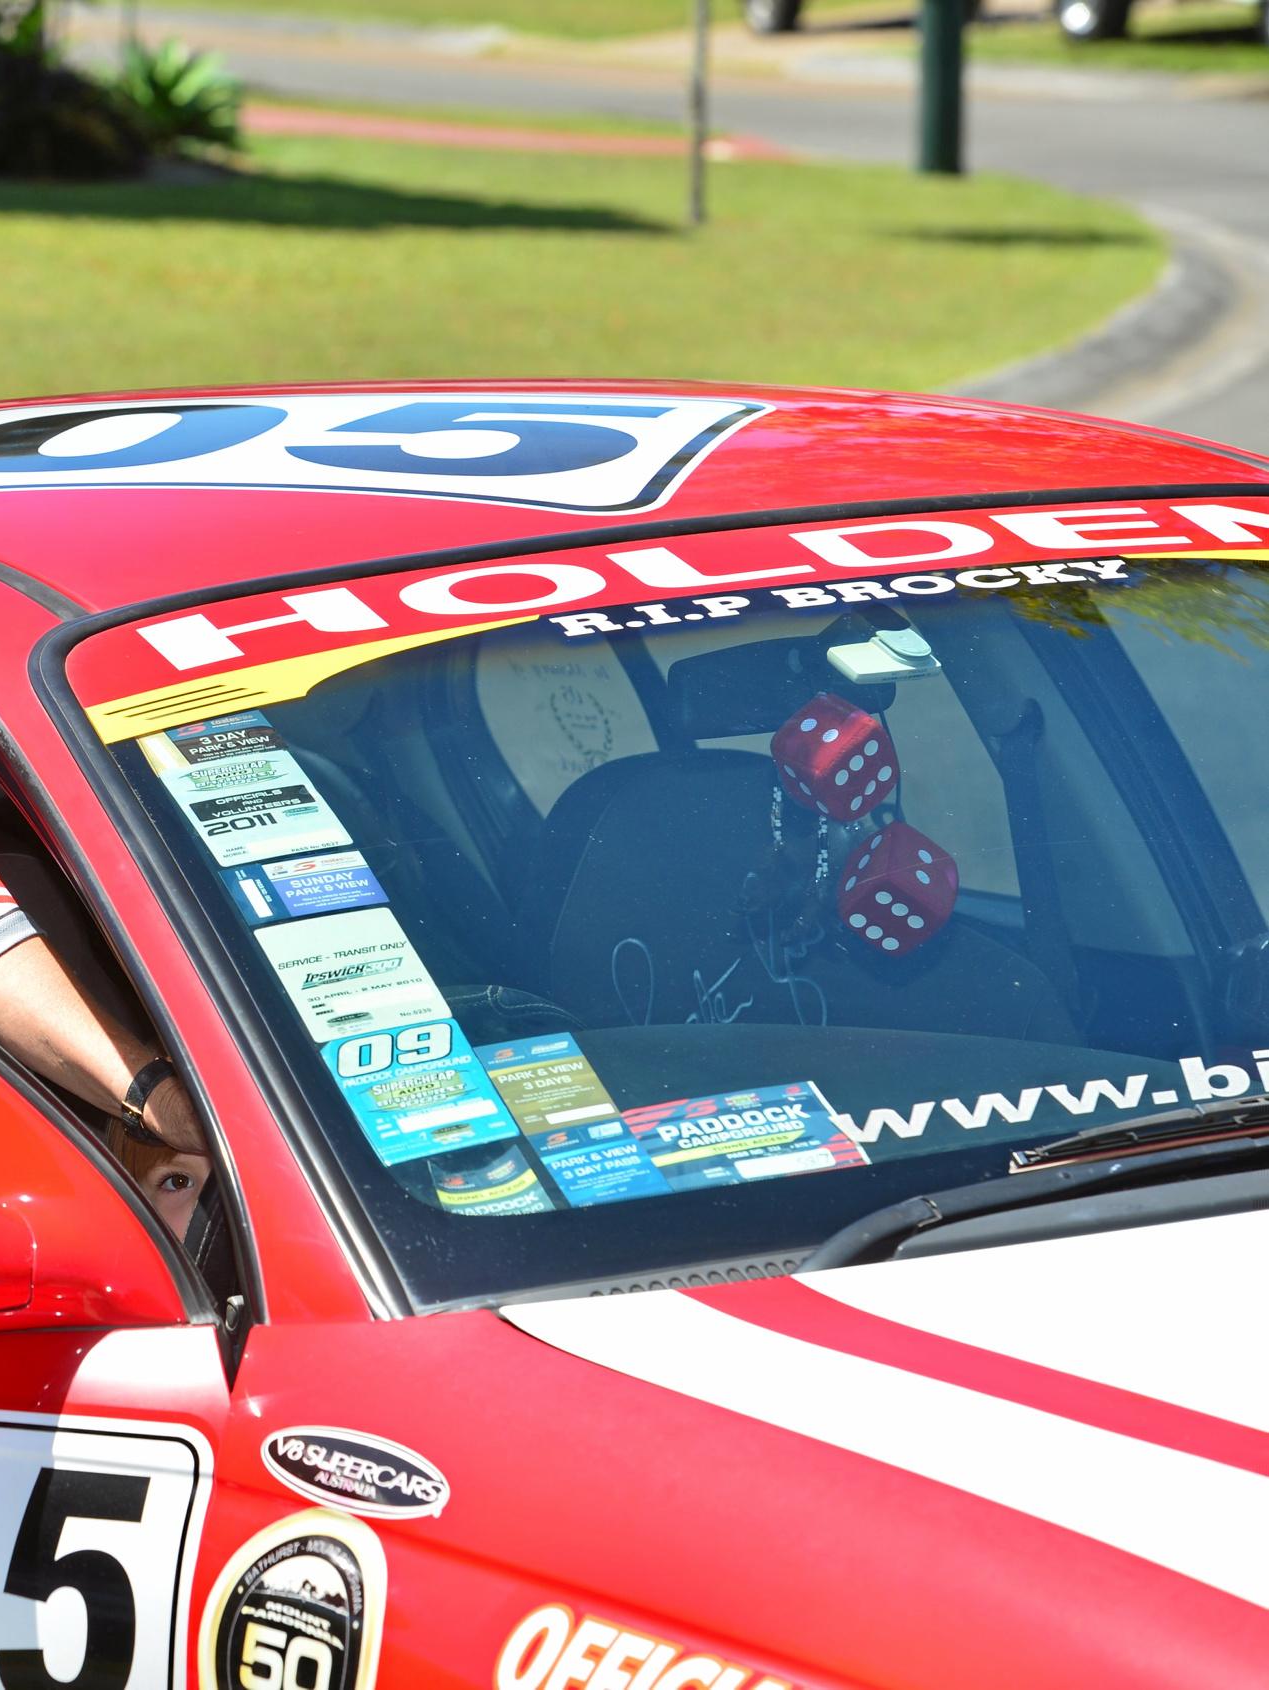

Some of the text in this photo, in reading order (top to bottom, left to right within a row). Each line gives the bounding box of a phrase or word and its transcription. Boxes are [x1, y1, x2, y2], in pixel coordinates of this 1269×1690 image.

[549, 560, 1128, 636] R.I.P BROCKY
[189, 744, 224, 755] PARK
[238, 736, 270, 747] VIEW
[200, 730, 247, 745] 3 DAY
[212, 798, 301, 818] VOLUNTEERS
[216, 789, 282, 805] OFFICIALS
[203, 812, 278, 837] 2011
[285, 885, 321, 898] PARK
[336, 879, 369, 891] VIEW
[290, 871, 354, 889] SUNDAY
[278, 955, 323, 970] SERVICE
[333, 945, 378, 960] TRANSIT
[380, 940, 408, 952] ONLY
[337, 1022, 453, 1079] 09
[372, 1069, 455, 1096] SUPERCHEAP
[497, 1070, 536, 1083] PARK
[549, 1062, 583, 1074] VIEW
[523, 1075, 572, 1090] 3 DAYS
[399, 1083, 434, 1095] AUTO
[656, 1103, 811, 1142] PADDOCK
[678, 1120, 805, 1149] CAMPGROUND
[551, 1156, 588, 1170] PARK
[603, 1144, 637, 1158] VIEW
[575, 1164, 603, 1178] DAY
[605, 1155, 641, 1170] PASS
[277, 1436, 446, 1502] V8 SUPERCARS
[313, 1471, 377, 1499] AUSTRALIA
[244, 1541, 300, 1585] BATHURST
[241, 1604, 345, 1651] PANORAMA
[265, 1600, 331, 1631] MOUNT
[239, 1621, 333, 1690] 50
